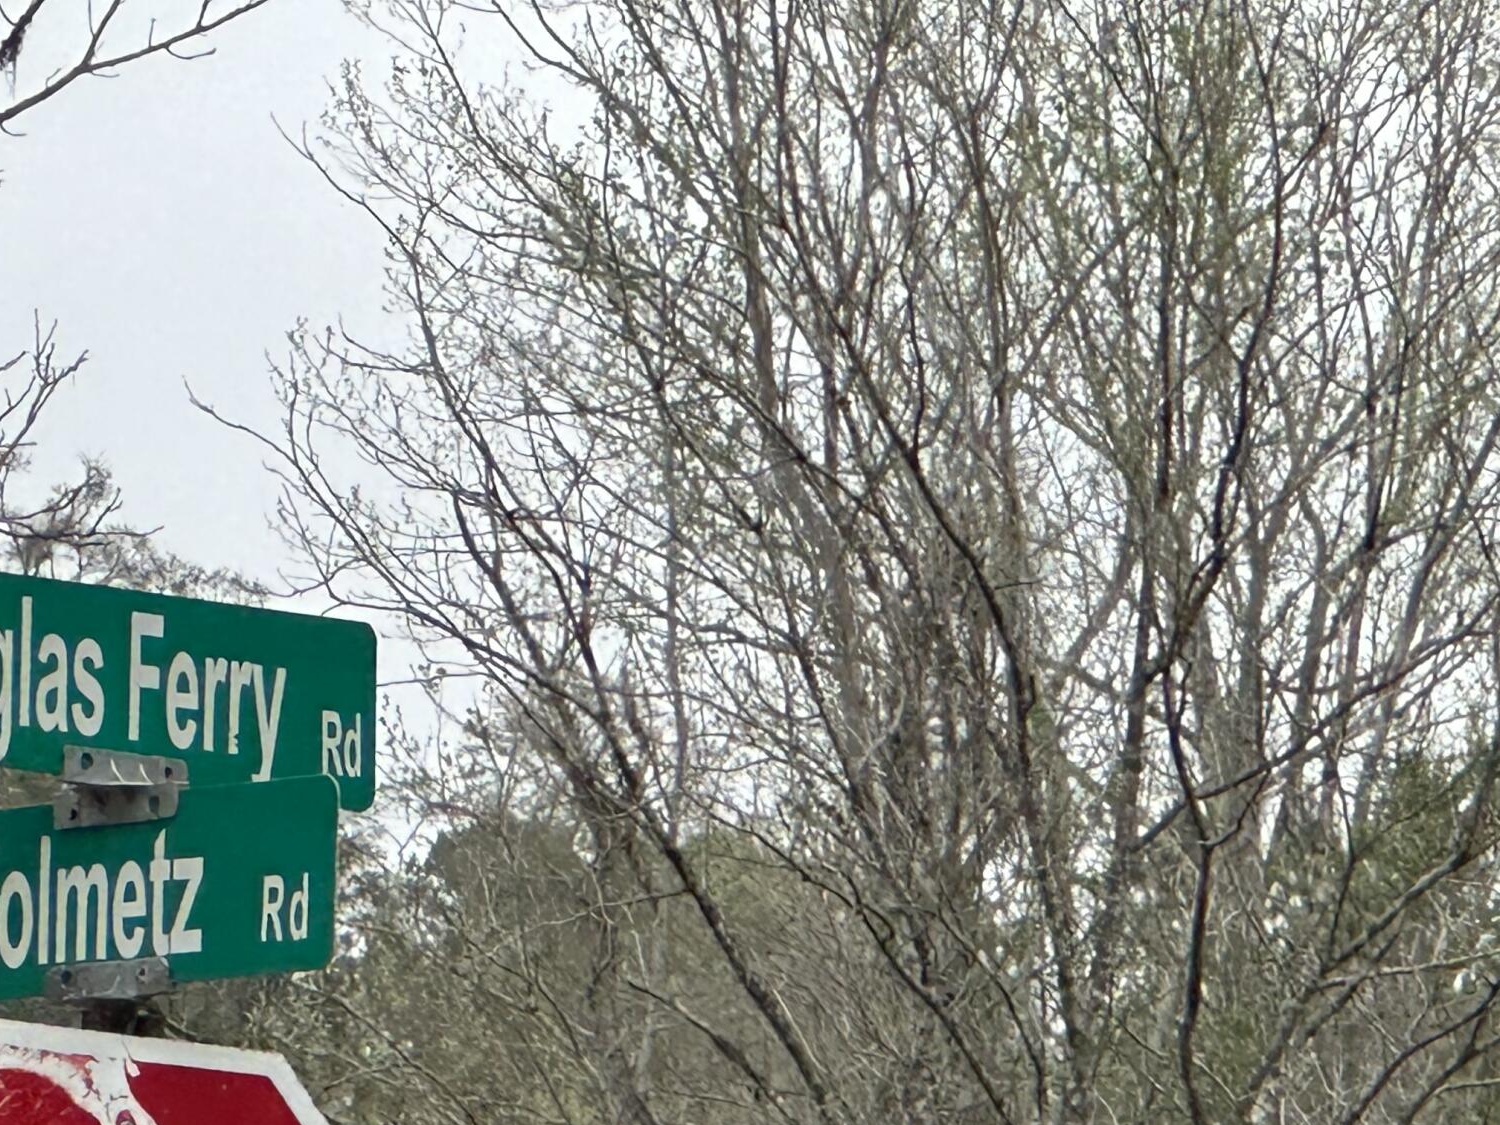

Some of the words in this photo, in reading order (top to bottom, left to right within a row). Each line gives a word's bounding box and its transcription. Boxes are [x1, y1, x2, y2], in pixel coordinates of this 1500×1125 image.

[127, 610, 288, 783] Ferry
[321, 710, 362, 778] Rd
[260, 872, 309, 943] Rd
